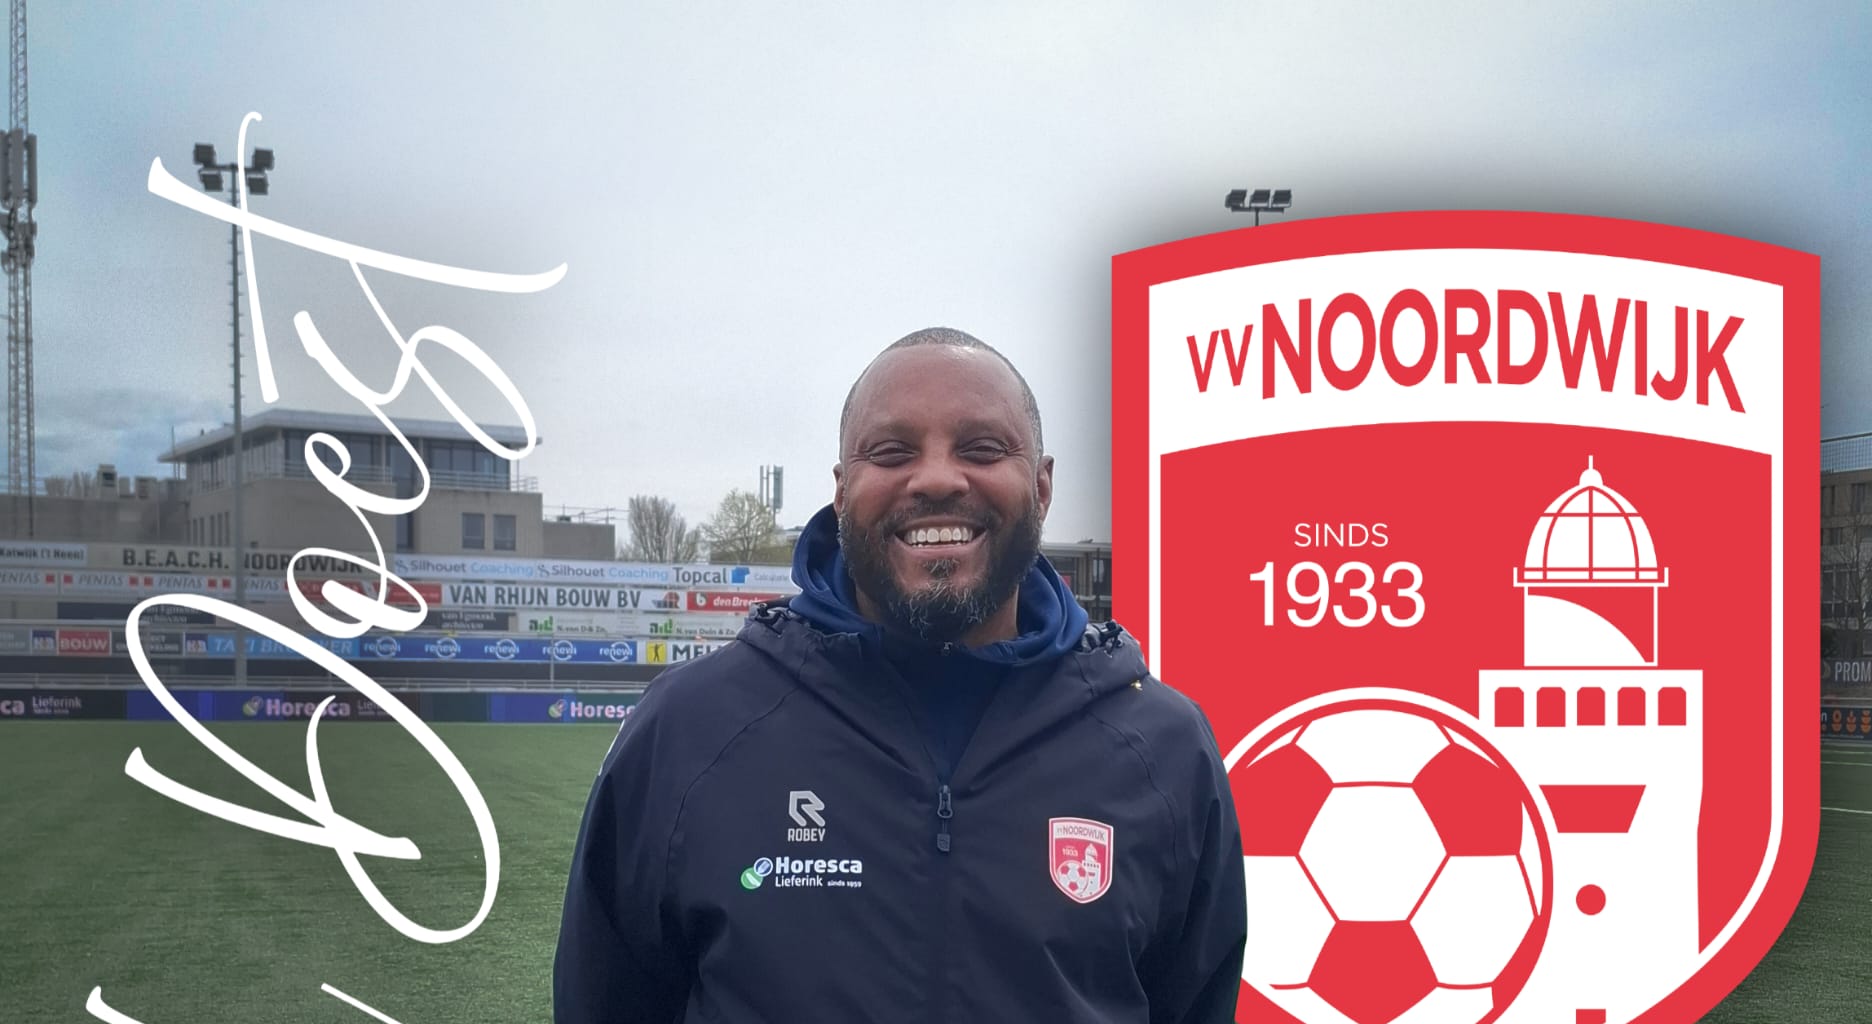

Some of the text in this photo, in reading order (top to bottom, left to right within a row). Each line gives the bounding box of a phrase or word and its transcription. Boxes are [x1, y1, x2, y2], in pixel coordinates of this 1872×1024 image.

[122, 549, 362, 573] B.E.A.C.H. OORDWIJK
[410, 560, 534, 576] Silhouet Coaching
[78, 573, 124, 587] PENTAS
[551, 564, 669, 582] Silhouet Coaching
[672, 567, 727, 585] Topcal
[158, 576, 203, 590] PENTAS
[450, 585, 487, 604] VAN
[495, 586, 548, 606] RHIJN
[556, 588, 611, 607] BOUW
[617, 590, 641, 608] BV
[60, 638, 108, 651] BOUW
[215, 638, 257, 653] TAI
[570, 701, 637, 719] Horesc
[787, 828, 826, 842] ROBEY
[775, 856, 863, 874] Horesca
[775, 875, 823, 887] Lieferink
